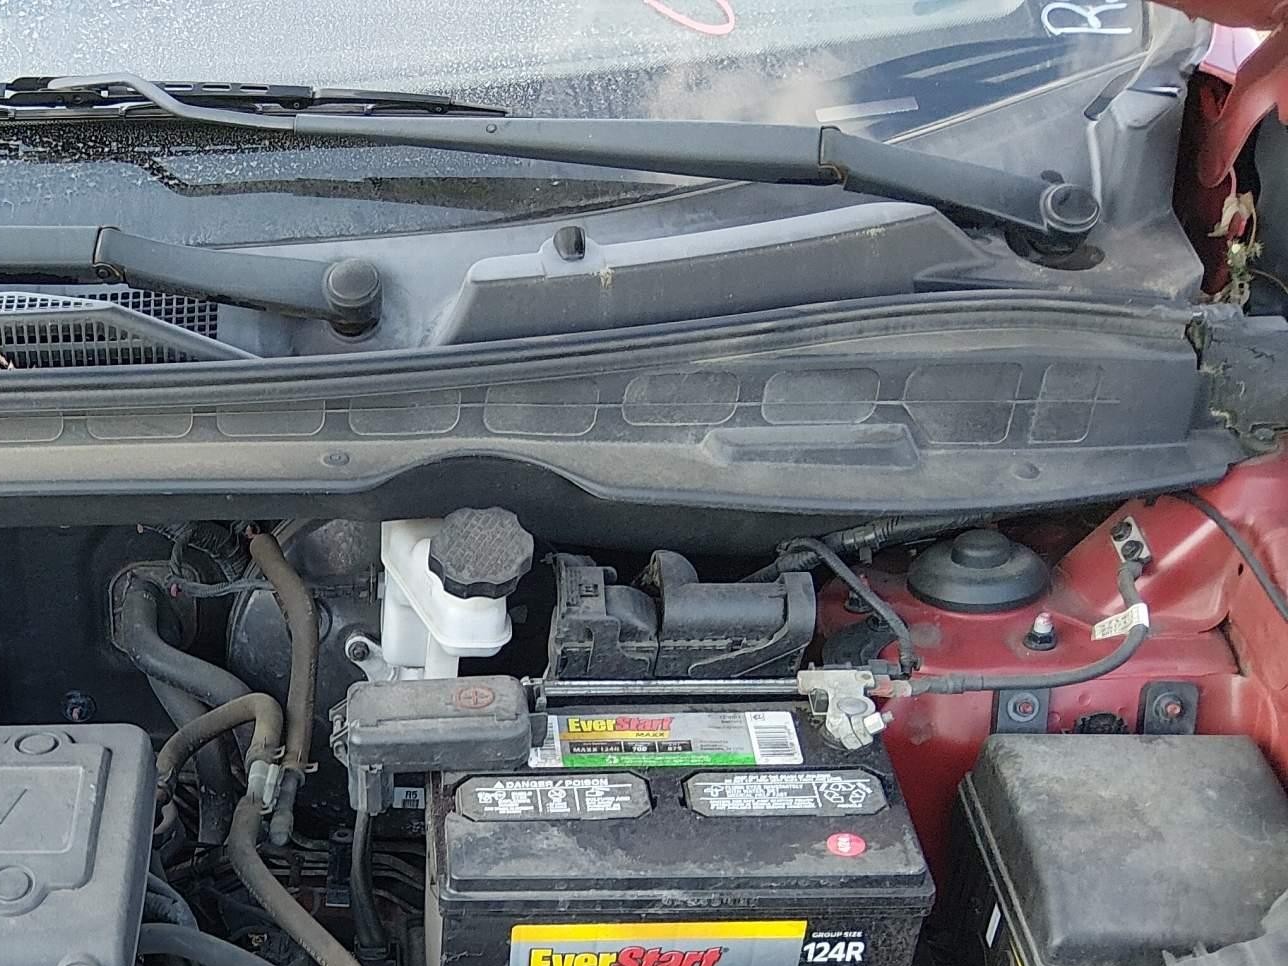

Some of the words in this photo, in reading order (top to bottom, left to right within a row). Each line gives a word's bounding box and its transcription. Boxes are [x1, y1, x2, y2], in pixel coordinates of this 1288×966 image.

[567, 716, 674, 733] EverStart
[506, 780, 553, 788] DANGER
[565, 778, 609, 787] POISON
[803, 941, 865, 963] 124R
